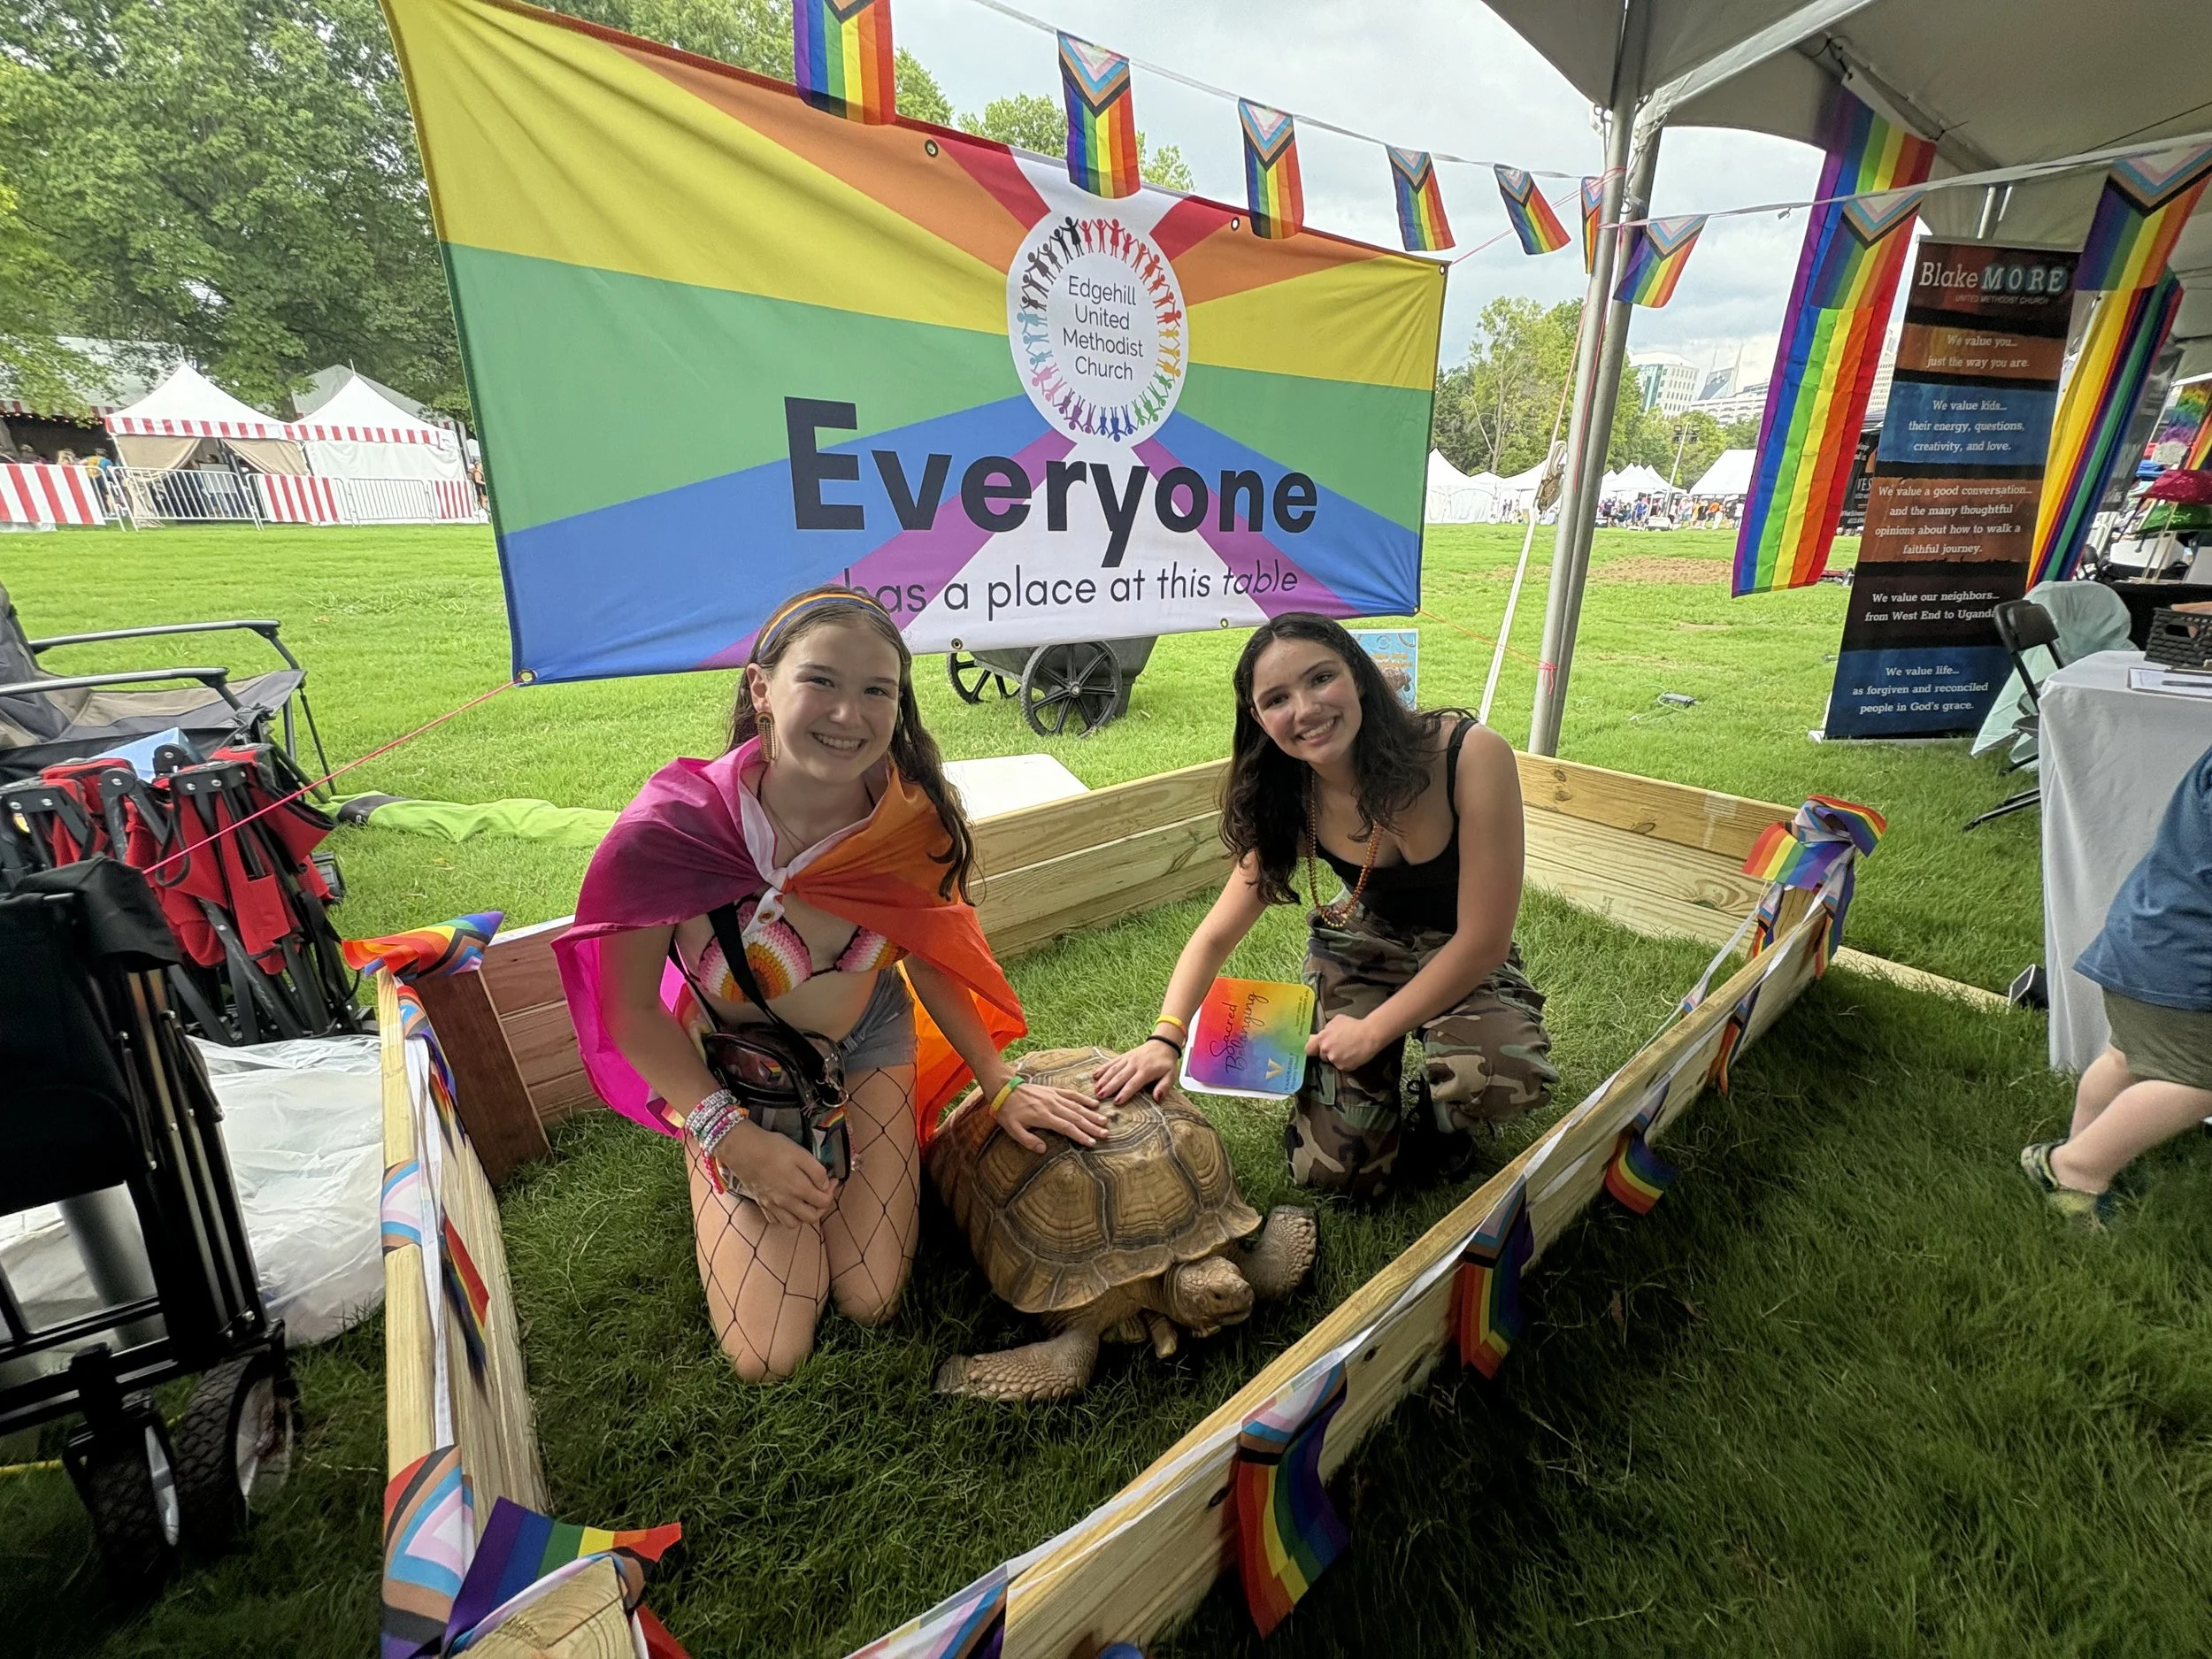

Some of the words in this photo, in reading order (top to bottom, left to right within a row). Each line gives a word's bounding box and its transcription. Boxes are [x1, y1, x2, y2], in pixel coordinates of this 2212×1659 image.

[1068, 275, 1137, 306] Edgehill
[1955, 295, 1979, 303] UNITED
[1980, 296, 2018, 304] METHODIST
[2018, 296, 2050, 305] CHURCH
[1075, 303, 1130, 331] United
[1063, 326, 1144, 357] Methodist
[1947, 334, 1962, 346] We
[1964, 335, 1993, 346] value
[1075, 356, 1133, 381] Church
[1926, 356, 1947, 368] just
[1948, 357, 1963, 367] the
[1966, 358, 1989, 369] way
[1990, 360, 2008, 370] you
[2009, 359, 2031, 368] are.
[1932, 400, 1948, 411] We
[1950, 400, 1978, 411] value
[1908, 420, 1932, 431] their
[1933, 423, 1971, 434] energy,
[1974, 421, 2025, 434] questions,
[1913, 441, 1963, 454] creativity,
[1966, 441, 1985, 451] and
[1986, 441, 2012, 451] love.
[784, 396, 1318, 568] Everyone
[1878, 486, 1893, 496] We
[1896, 486, 1922, 496] value
[1924, 488, 1931, 496] a
[1933, 486, 1959, 498] good
[1889, 506, 1908, 516] and
[1910, 505, 1926, 516] the
[1928, 507, 1958, 517] many
[1960, 503, 2014, 517] thoughtful
[1875, 526, 1916, 538] opinions
[1917, 525, 1947, 535] about
[1949, 524, 1970, 534] how
[1972, 524, 1984, 534] to
[1986, 523, 2013, 534] walk
[1901, 543, 1939, 555] faithful
[1940, 543, 1983, 556] journey.
[944, 582, 969, 611] a
[987, 564, 1096, 622] place
[1110, 569, 1146, 603] at
[1156, 561, 1211, 600] this
[1222, 558, 1298, 595] table
[1872, 593, 1888, 603] We
[1891, 592, 1918, 603] value
[1920, 594, 1939, 603] our
[1864, 611, 1889, 622] from
[1892, 611, 1918, 621] West
[1920, 610, 1941, 620] End
[1944, 611, 1955, 619] to
[1886, 667, 1903, 677] We
[1905, 666, 1933, 676] value
[1866, 685, 1910, 697] forgiven
[1912, 684, 1932, 694] and
[1934, 681, 1989, 693] reconciled
[1859, 703, 1894, 715] people
[1895, 702, 1908, 712] in
[1909, 701, 1940, 711] God's
[1942, 702, 1975, 712] grace.
[1209, 1002, 1239, 1057] Sacred
[1225, 991, 1270, 1074] Belonging
